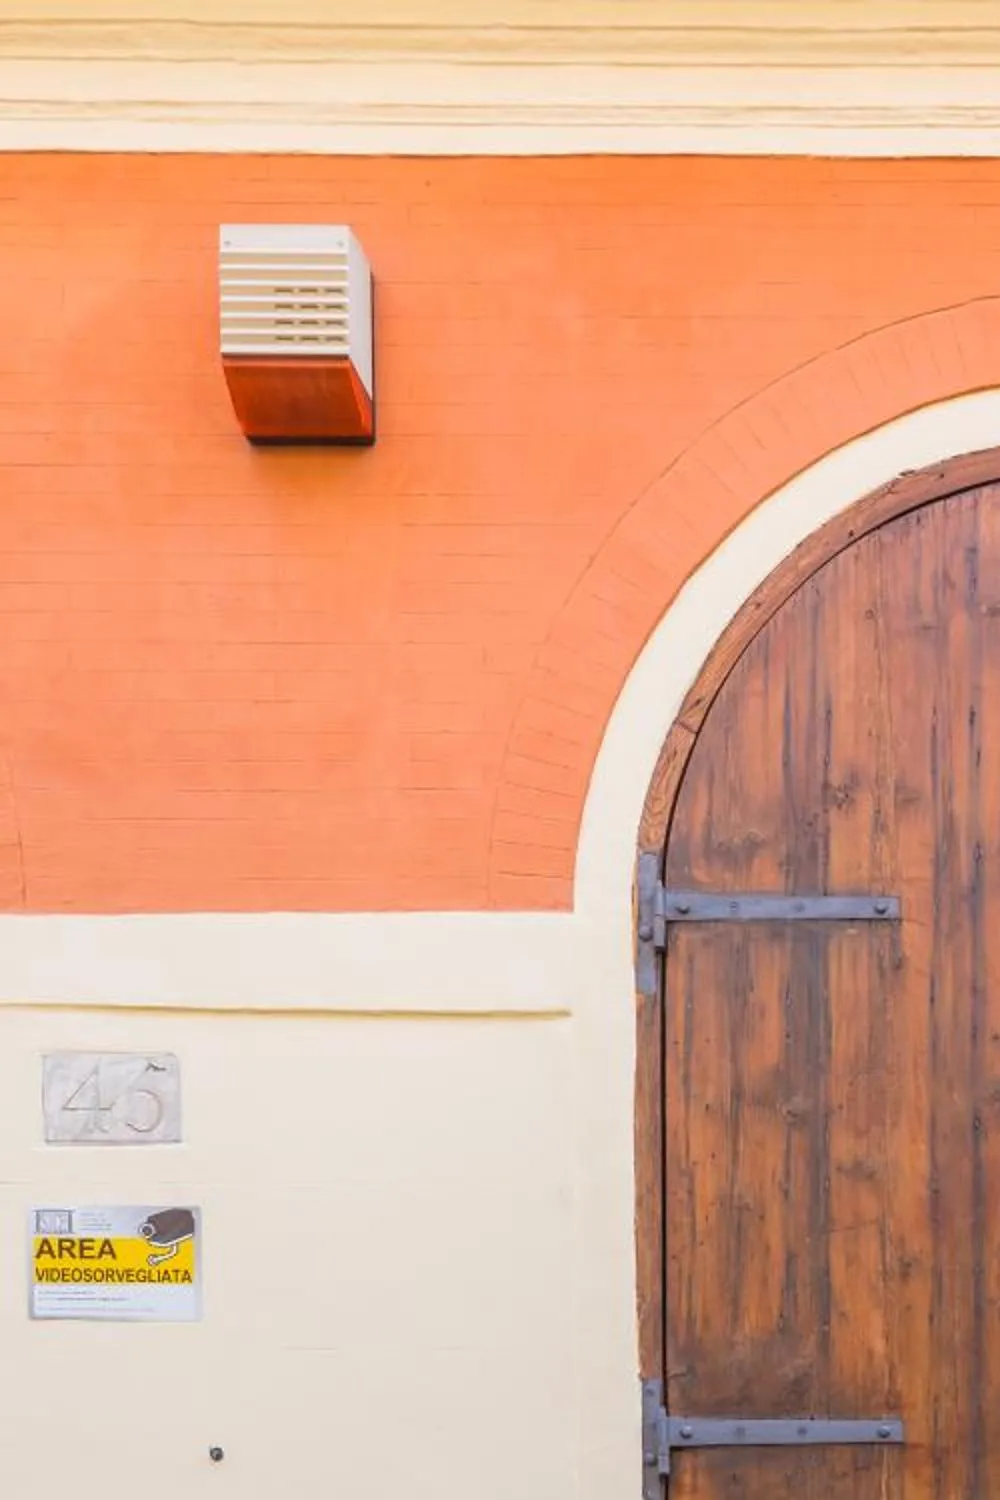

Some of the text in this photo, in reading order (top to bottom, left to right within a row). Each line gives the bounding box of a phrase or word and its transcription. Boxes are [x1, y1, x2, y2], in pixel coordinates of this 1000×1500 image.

[61, 1058, 167, 1133] 45
[35, 1237, 117, 1260] AREA
[35, 1266, 193, 1284] VIDEOSORVEGLIATA
